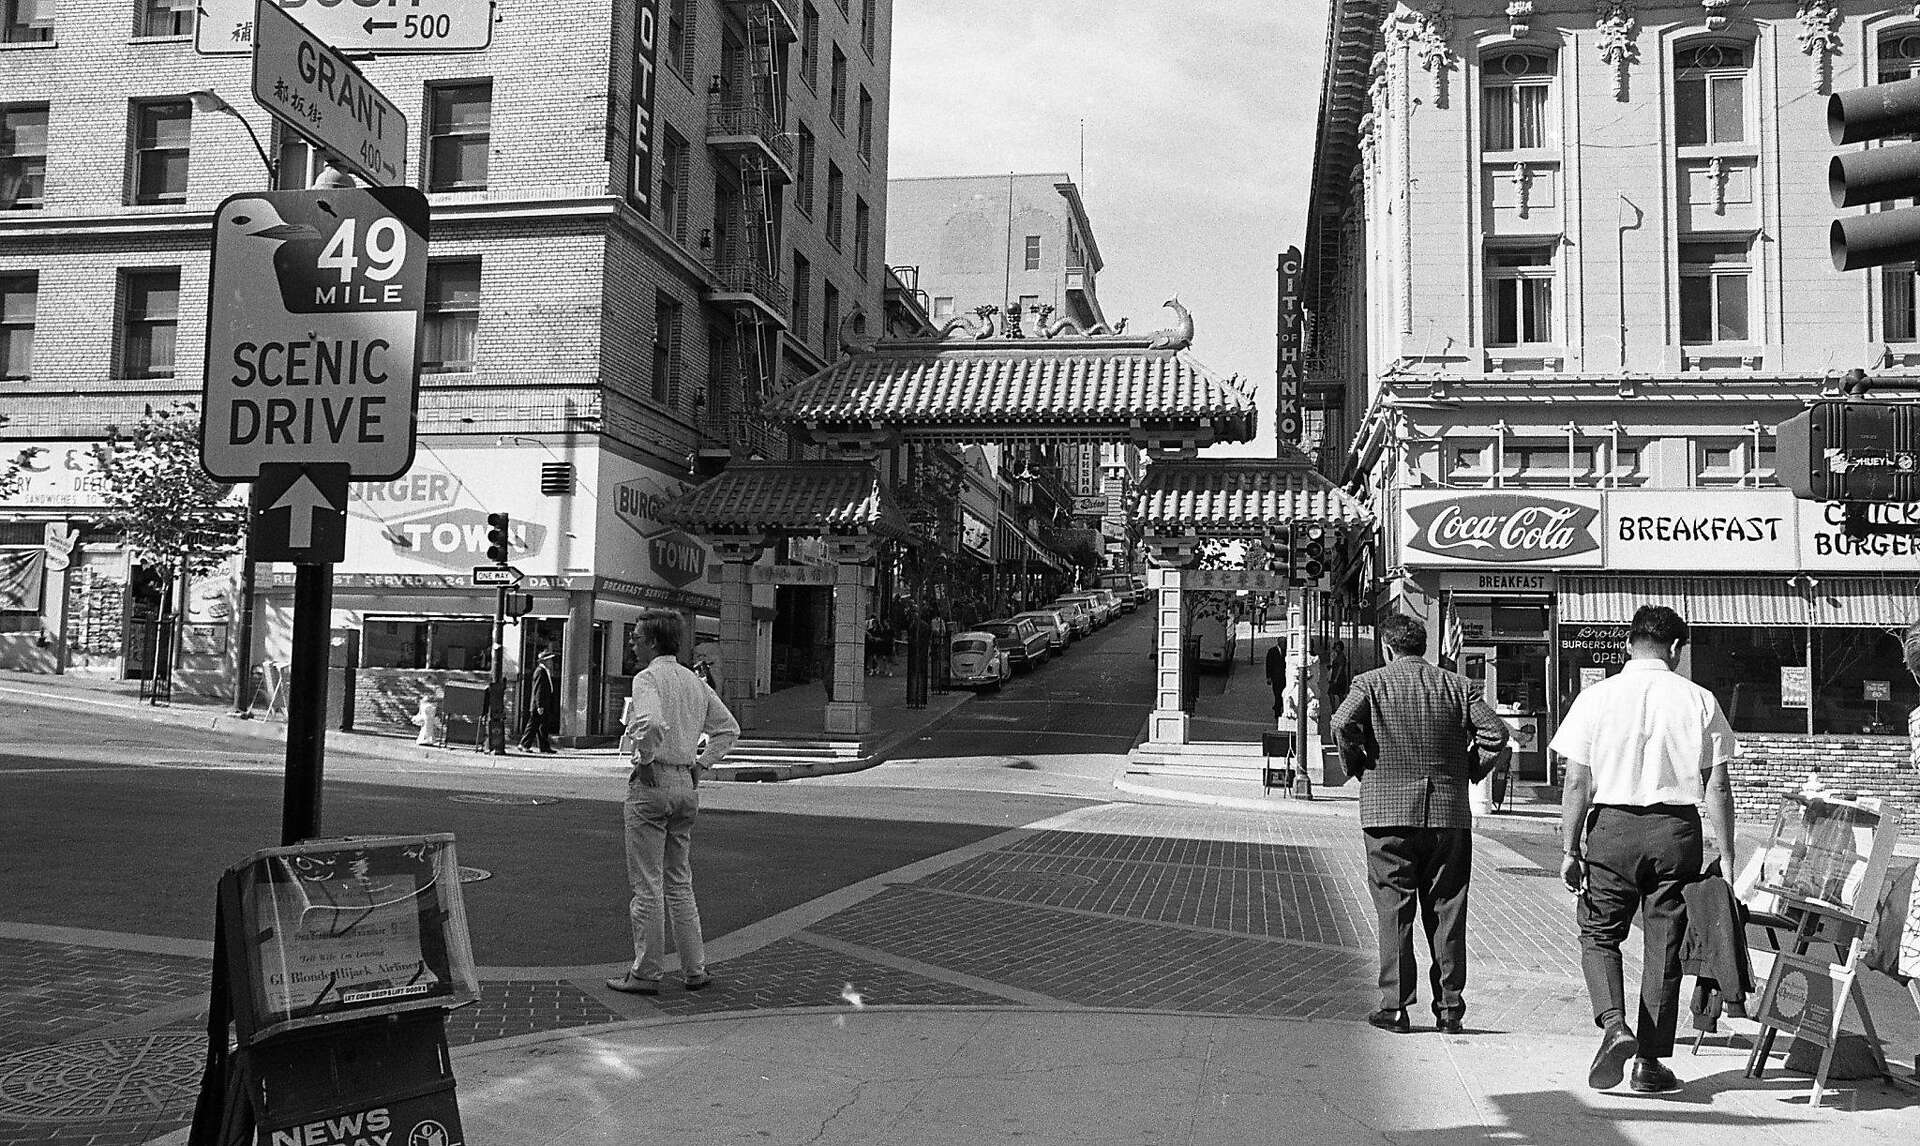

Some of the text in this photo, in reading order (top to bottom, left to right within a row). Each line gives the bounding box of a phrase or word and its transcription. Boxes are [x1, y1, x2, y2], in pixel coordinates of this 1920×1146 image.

[404, 14, 450, 38] 500
[297, 40, 386, 139] GRANT
[635, 0, 654, 204] OTEL
[360, 139, 381, 172] 400
[317, 217, 407, 283] 49
[315, 285, 403, 304] MILE
[1282, 260, 1298, 328] CITY
[1282, 334, 1298, 342] OF
[231, 339, 389, 388] SCENIC
[229, 397, 387, 445] DRIVE
[64, 450, 83, 470] &
[1428, 505, 1580, 549] Coca-Cola
[1619, 516, 1782, 541] BREAKFAST
[1824, 503, 1920, 525] CICK
[404, 523, 526, 553] TOWN
[656, 540, 699, 573] TOWN
[445, 575, 465, 586] 24
[529, 577, 574, 587] DAILY
[603, 580, 642, 596] BREAKFAST
[1479, 575, 1544, 588] BREAKFAST
[1592, 652, 1625, 664] OPEN
[271, 1108, 390, 1146] NEWS
